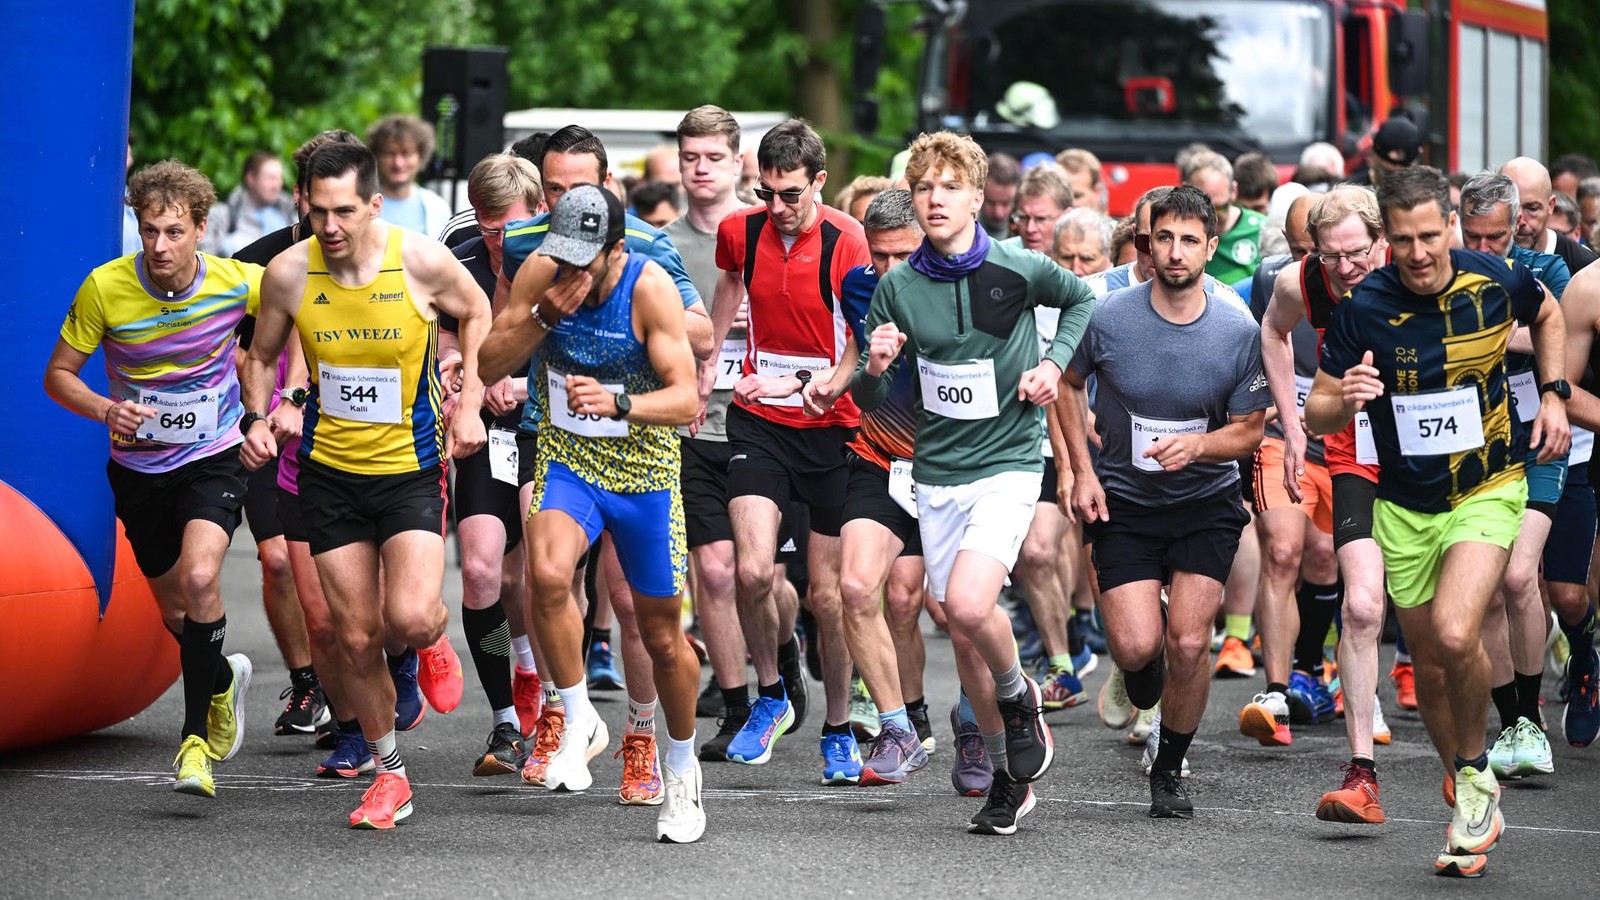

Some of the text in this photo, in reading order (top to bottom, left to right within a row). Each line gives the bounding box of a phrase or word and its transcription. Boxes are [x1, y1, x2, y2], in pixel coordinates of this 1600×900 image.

[379, 291, 404, 300] bunert
[157, 320, 192, 328] Christian
[313, 327, 402, 343] TSV WEEZE
[769, 361, 791, 369] Volksbank
[929, 370, 950, 379] Volksbank
[951, 372, 981, 380] Schermbeck
[340, 385, 378, 403] 544
[937, 385, 973, 404] 600
[1405, 404, 1432, 412] Volksbank
[1433, 399, 1465, 410] Schermbeck
[160, 411, 196, 430] 649
[1418, 416, 1458, 438] 574
[1143, 424, 1168, 434] Volksbank
[1168, 424, 1196, 434] Schermbeck
